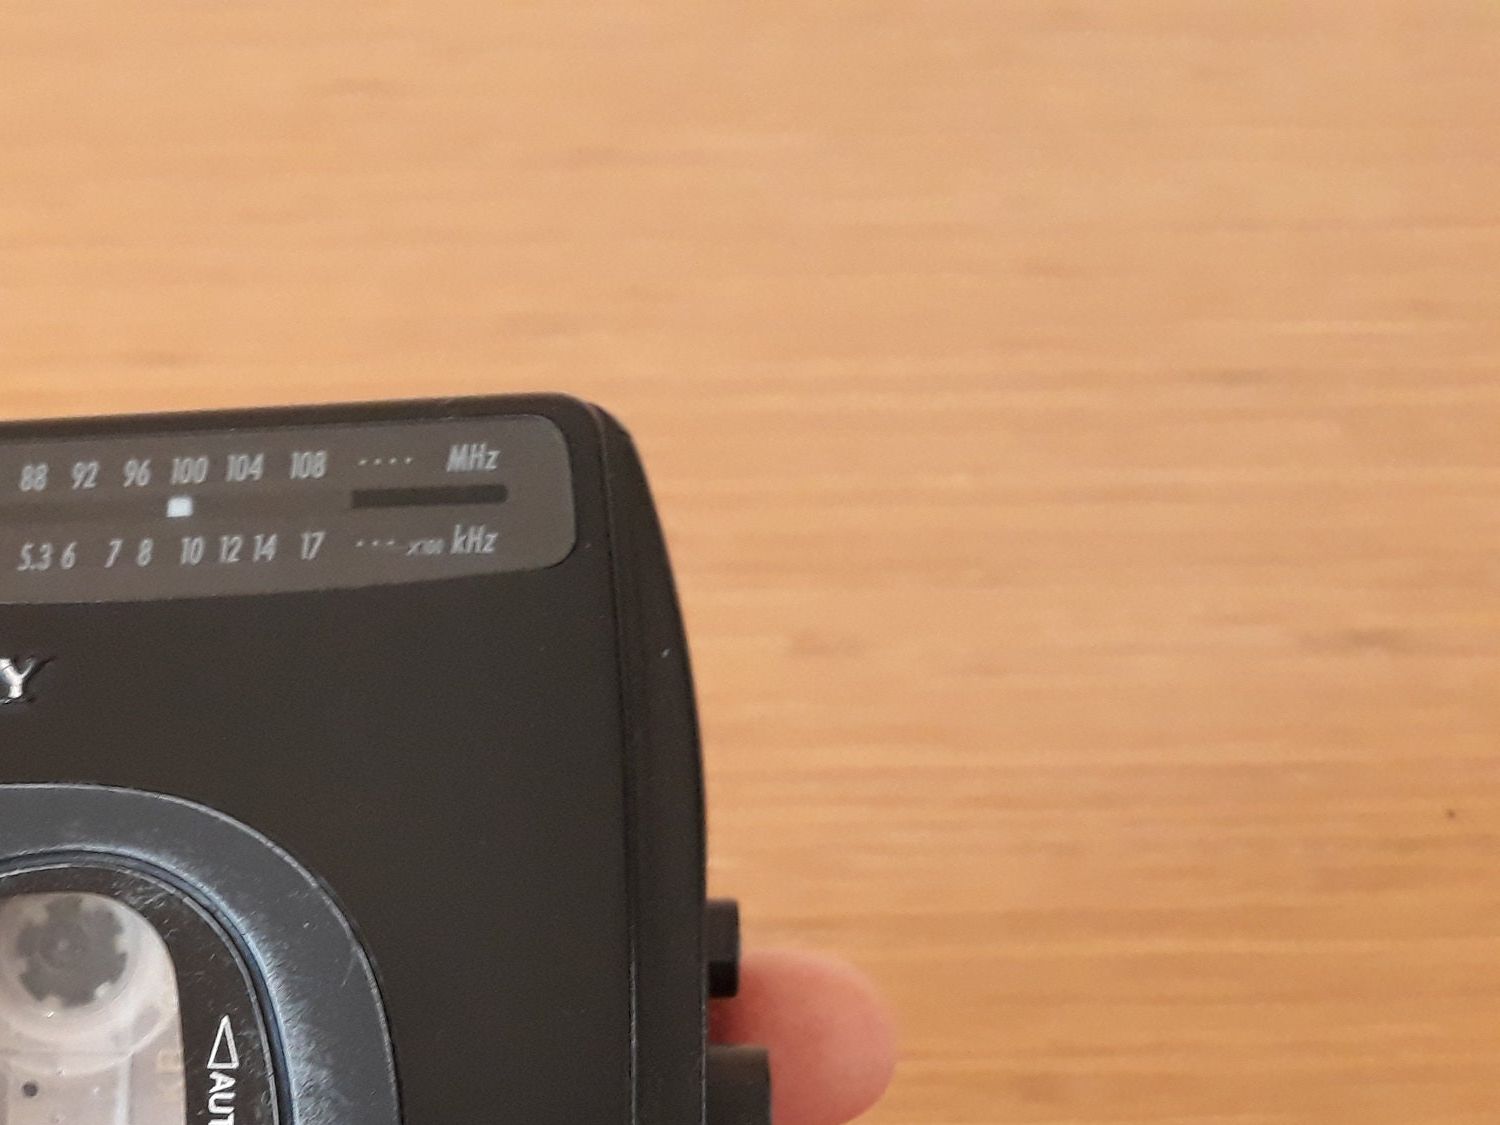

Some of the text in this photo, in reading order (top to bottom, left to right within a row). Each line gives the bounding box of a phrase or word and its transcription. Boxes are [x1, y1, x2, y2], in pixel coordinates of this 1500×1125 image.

[19, 463, 49, 491] 88
[71, 460, 99, 489] 92
[123, 458, 151, 487] 96
[170, 456, 208, 485] 100
[226, 453, 264, 482] 104
[290, 450, 327, 479] 108
[446, 440, 500, 472] MHz
[60, 541, 77, 570] 6
[104, 538, 123, 568] 7
[137, 537, 153, 567] 8
[180, 535, 205, 565] 10
[220, 534, 243, 563] 12
[252, 533, 278, 562] 14
[301, 530, 326, 560] 17
[450, 523, 499, 555] kHz
